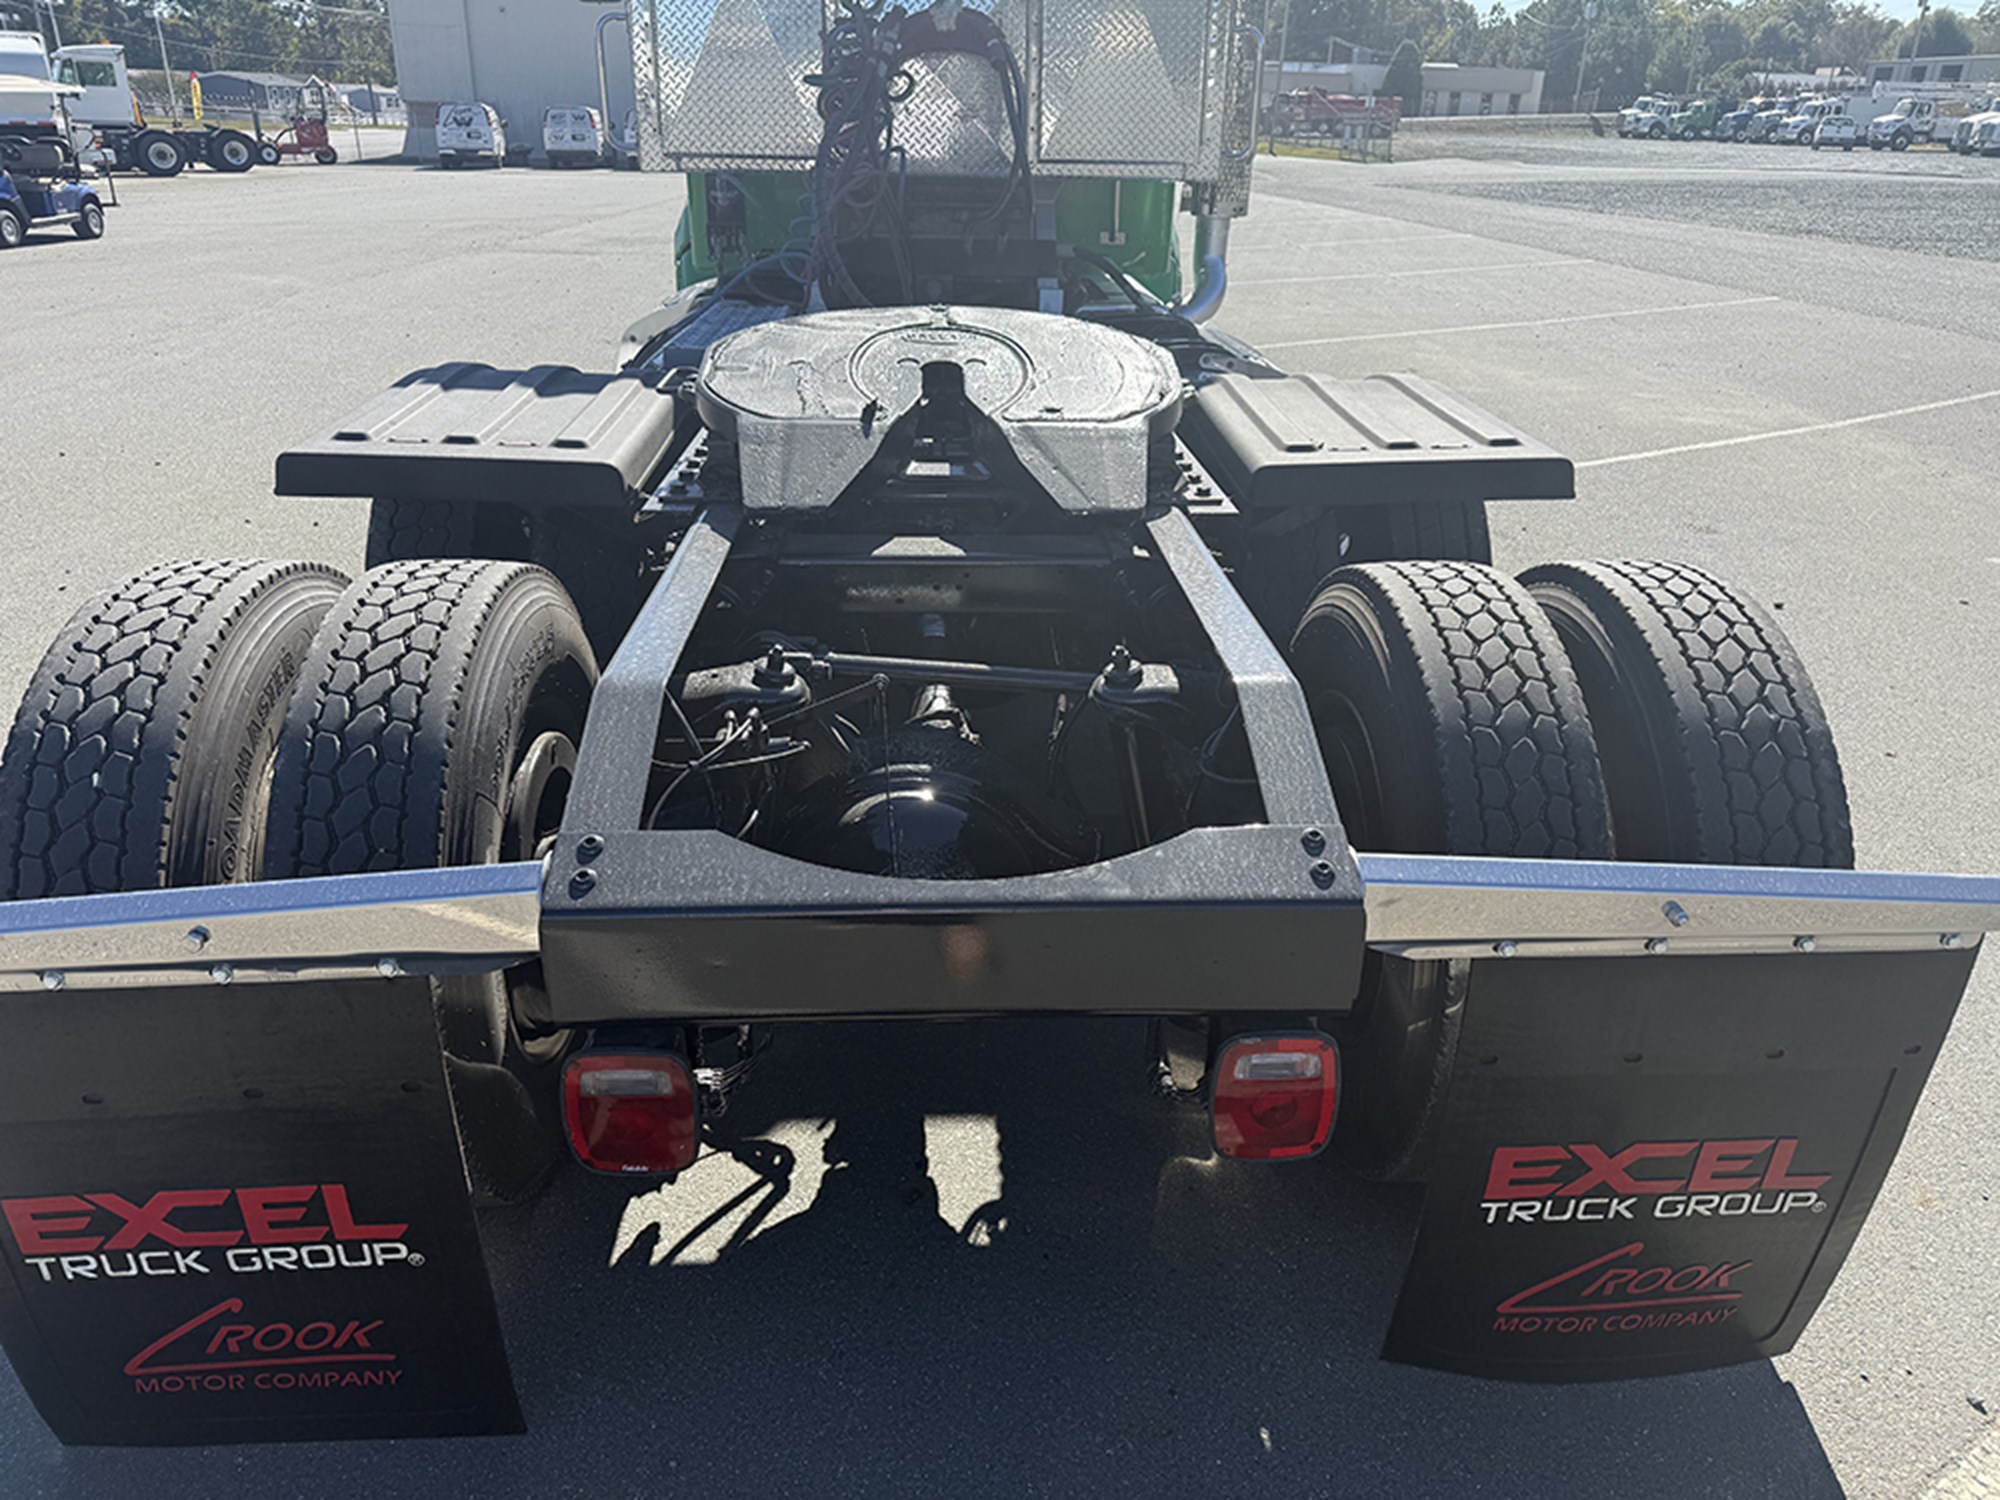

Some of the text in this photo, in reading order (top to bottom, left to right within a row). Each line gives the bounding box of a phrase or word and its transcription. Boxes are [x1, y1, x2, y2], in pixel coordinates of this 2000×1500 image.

[1484, 1139, 1832, 1199] EXCEL
[1, 1184, 408, 1255] EXCEL
[1481, 1198, 1638, 1224] TRUCK
[25, 1250, 210, 1281] TRUCK
[1493, 1307, 1738, 1332] MOTOR COMPANY
[135, 1370, 402, 1393] MOTOR COMPANY
